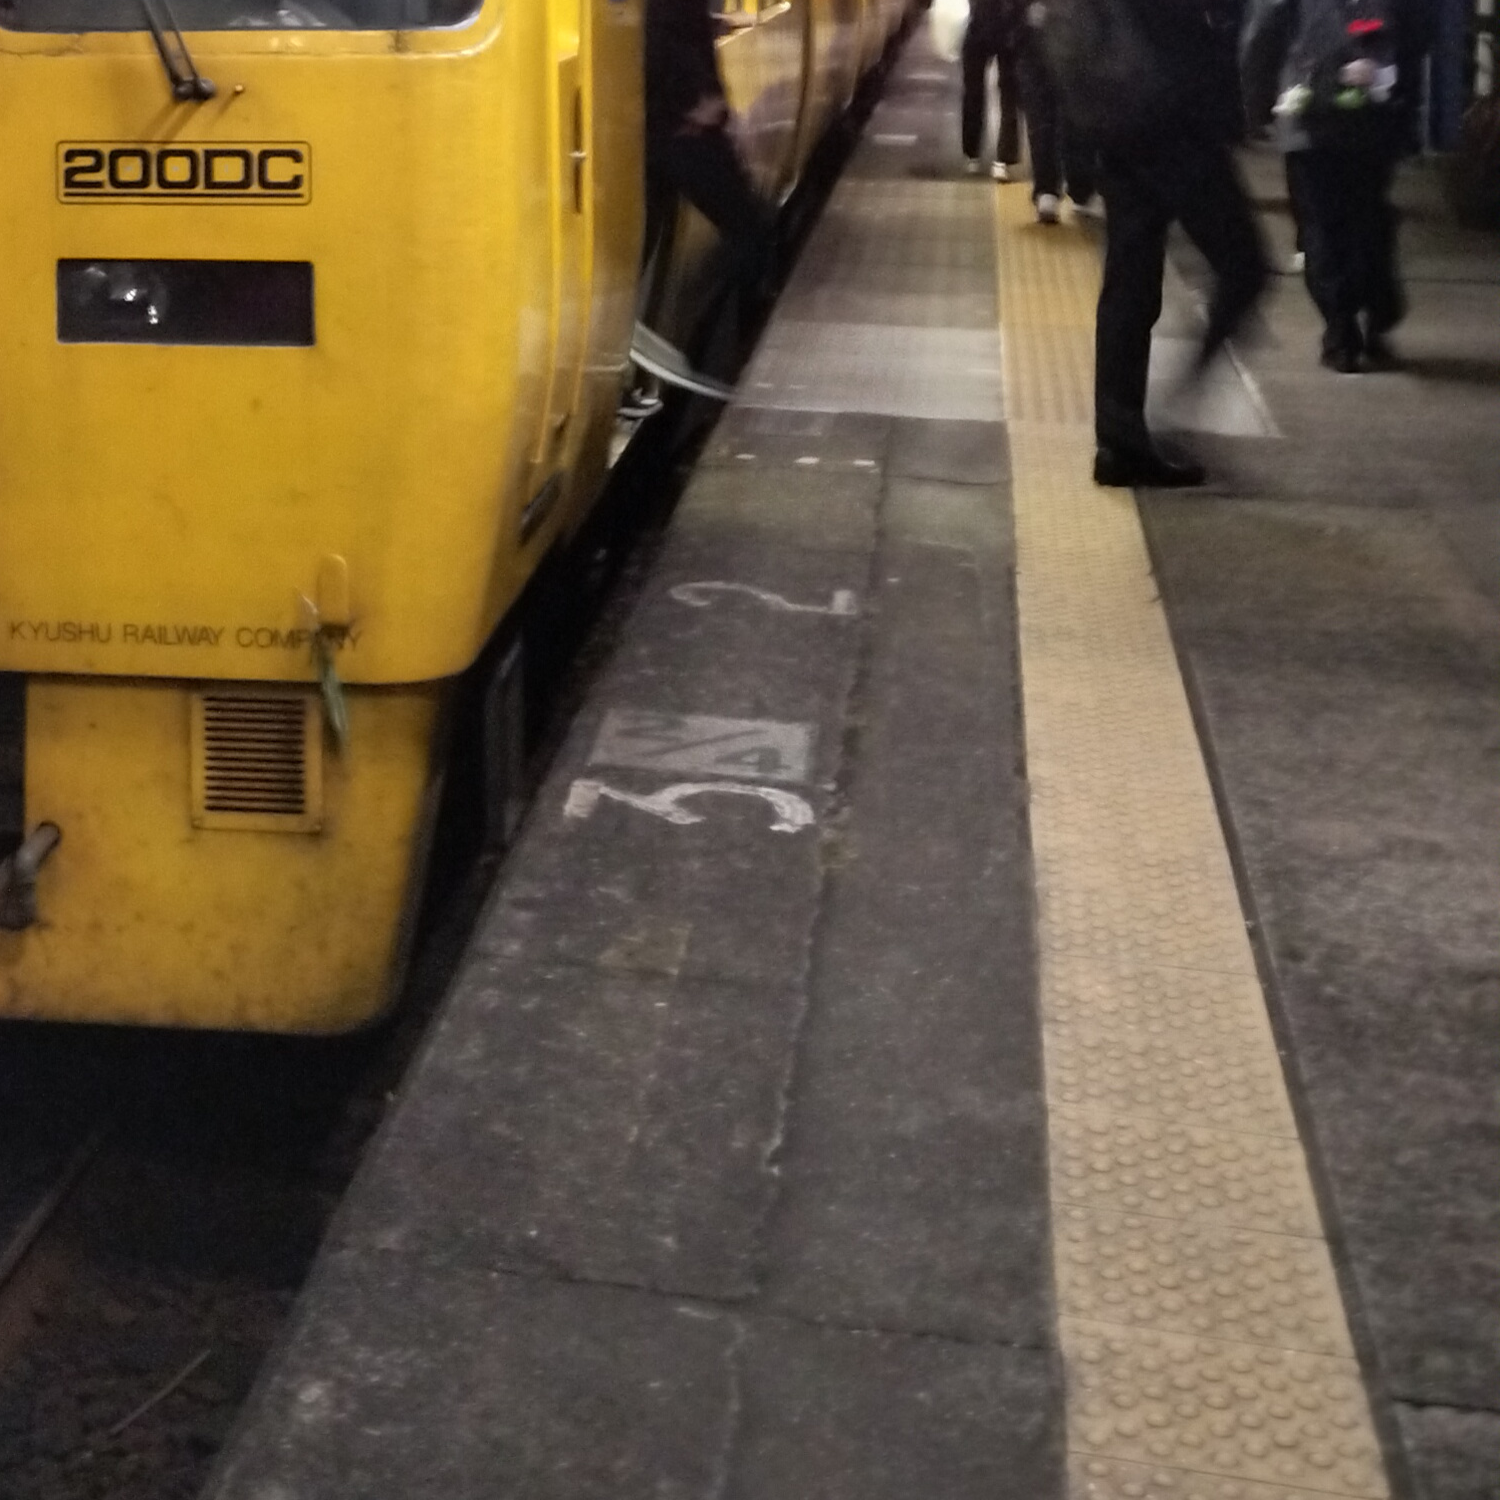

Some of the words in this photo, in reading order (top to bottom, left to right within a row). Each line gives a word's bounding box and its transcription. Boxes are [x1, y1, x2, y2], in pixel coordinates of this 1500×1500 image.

[63, 148, 304, 191] 200DC
[8, 621, 112, 644] KYUSHU
[123, 624, 225, 647] RAILWAY
